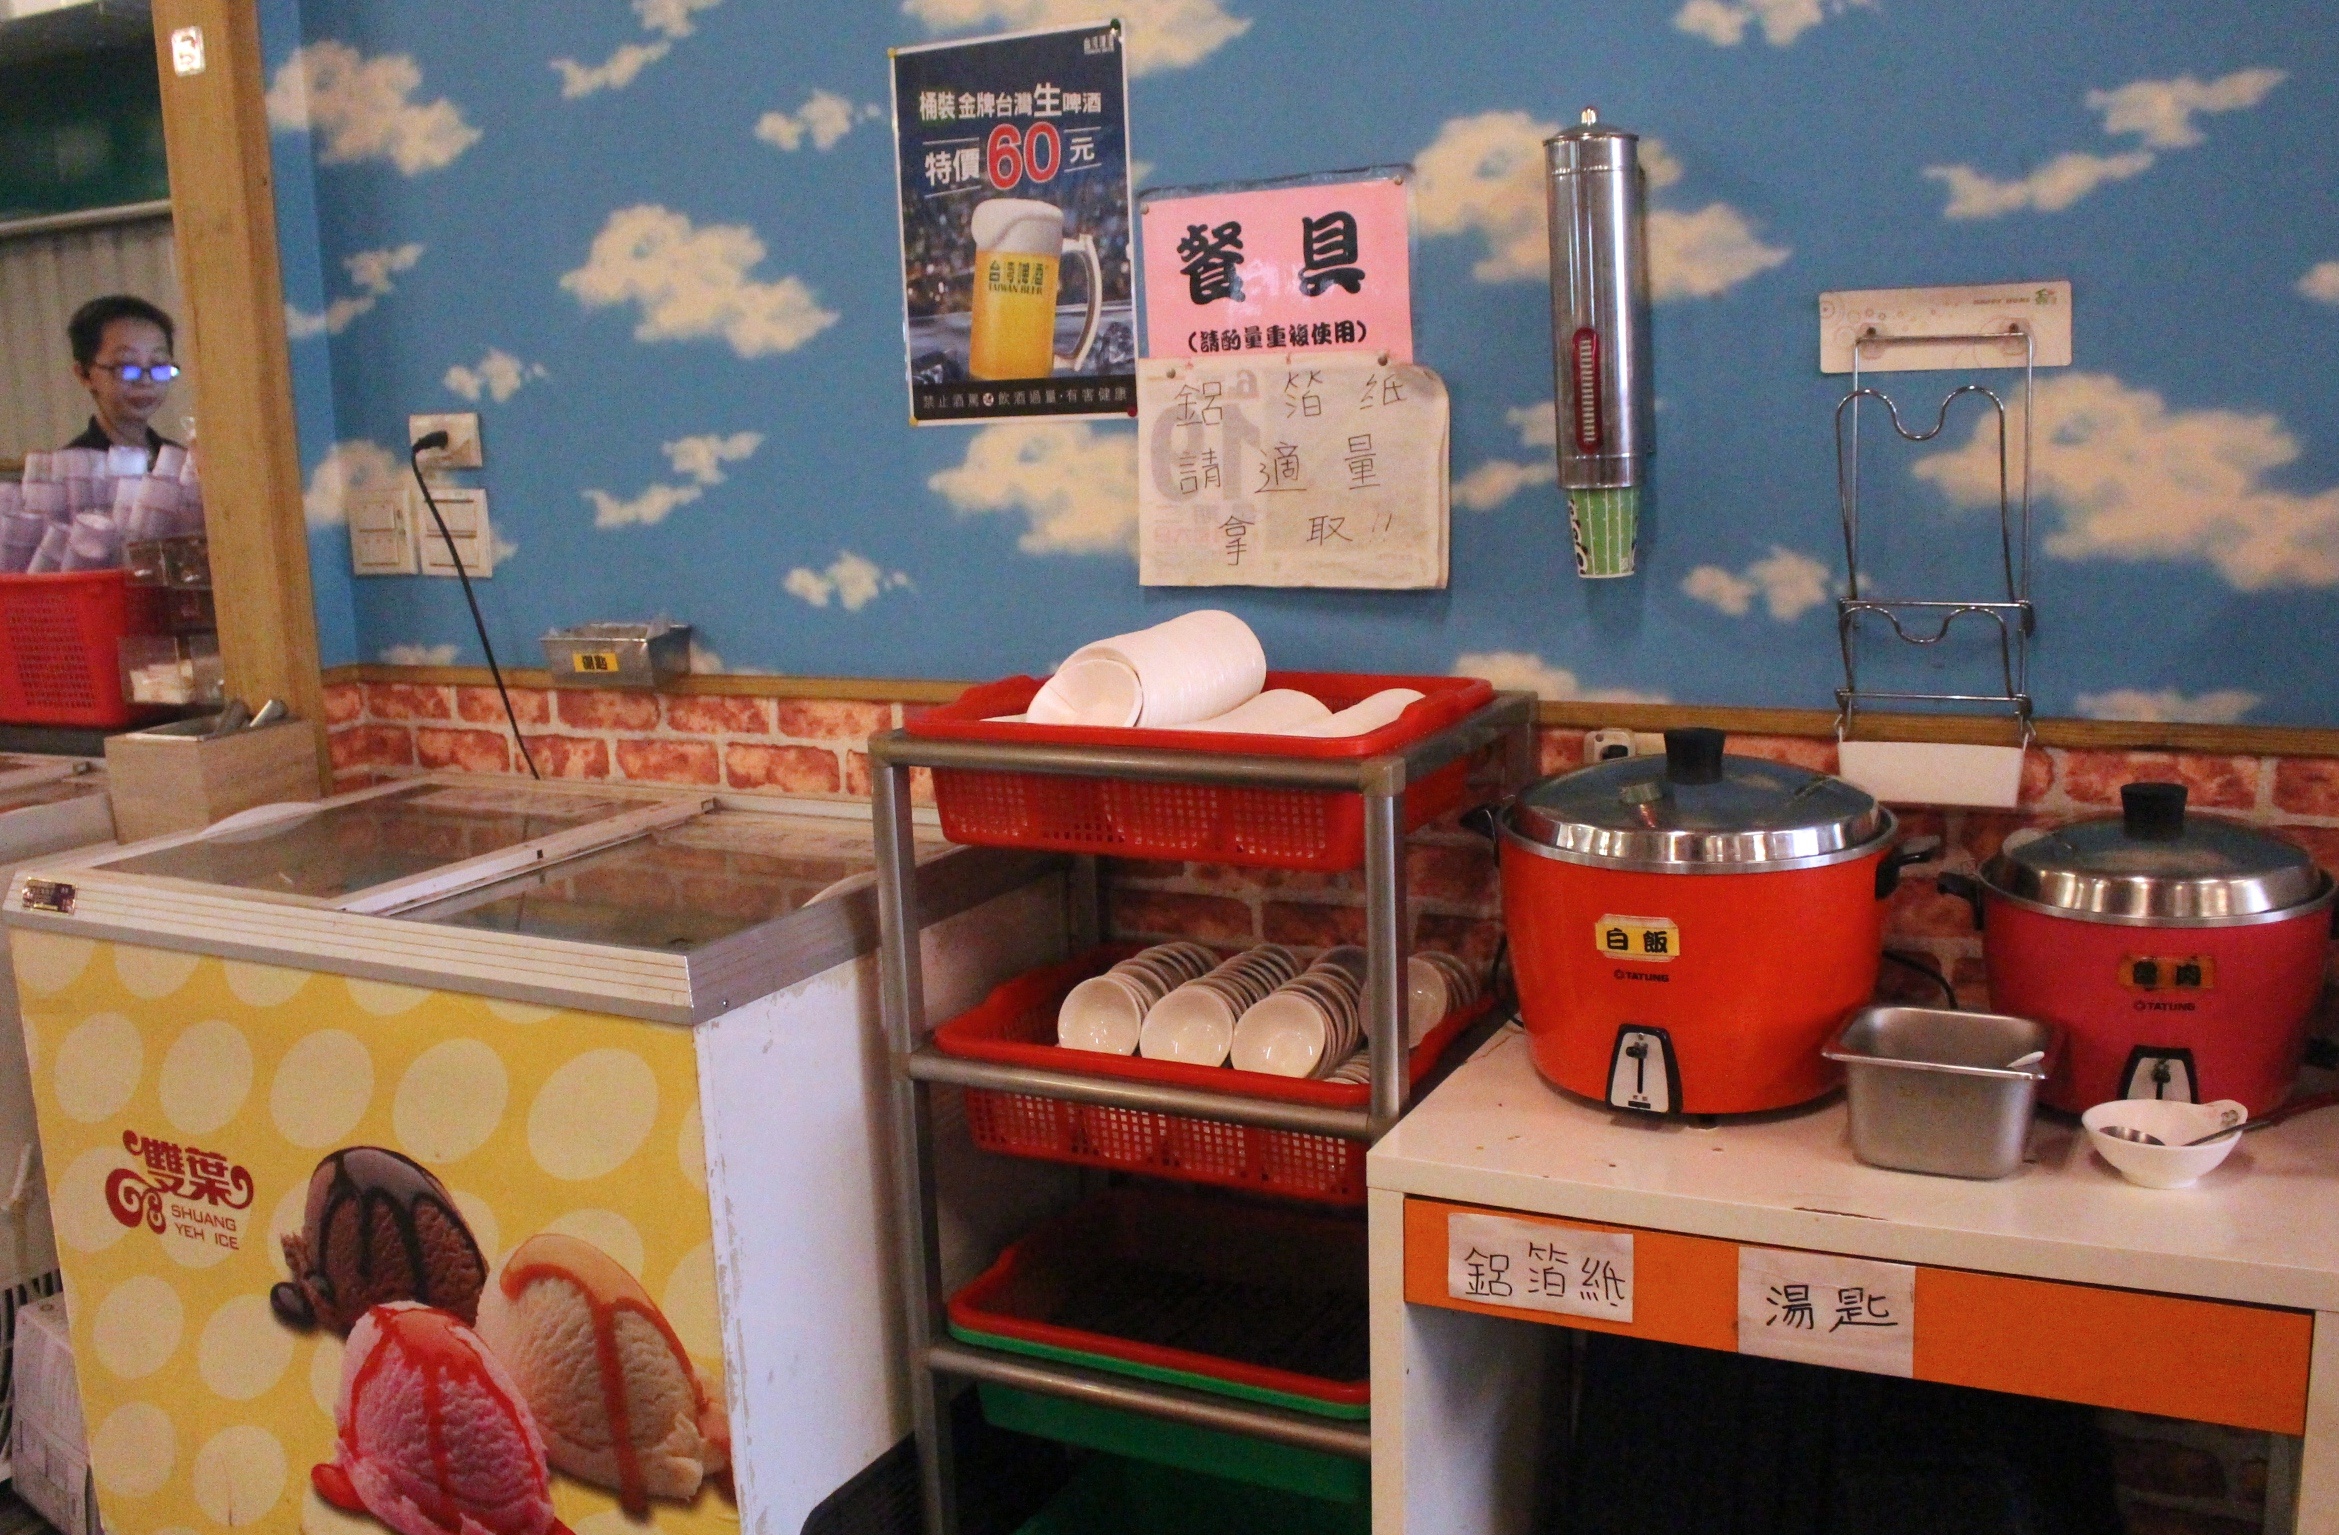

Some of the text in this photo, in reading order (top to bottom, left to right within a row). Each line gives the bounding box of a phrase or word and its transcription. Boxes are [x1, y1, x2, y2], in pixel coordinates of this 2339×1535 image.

[919, 82, 1102, 121] 桶裝金牌台灣生啤酒
[924, 122, 1095, 190] 特價 60 元
[1176, 211, 1366, 306] 餐具
[988, 282, 1043, 295] TAIWAN BEER
[1606, 928, 1668, 953] 白飯
[1625, 971, 1669, 983] TATUNG
[2145, 1002, 2196, 1011] TATUNG
[171, 1205, 236, 1231] SHUANG
[175, 1223, 239, 1250] YEH ICE
[1465, 1242, 1625, 1308] 鋁箔紙
[1766, 1284, 1898, 1333] 湯匙
